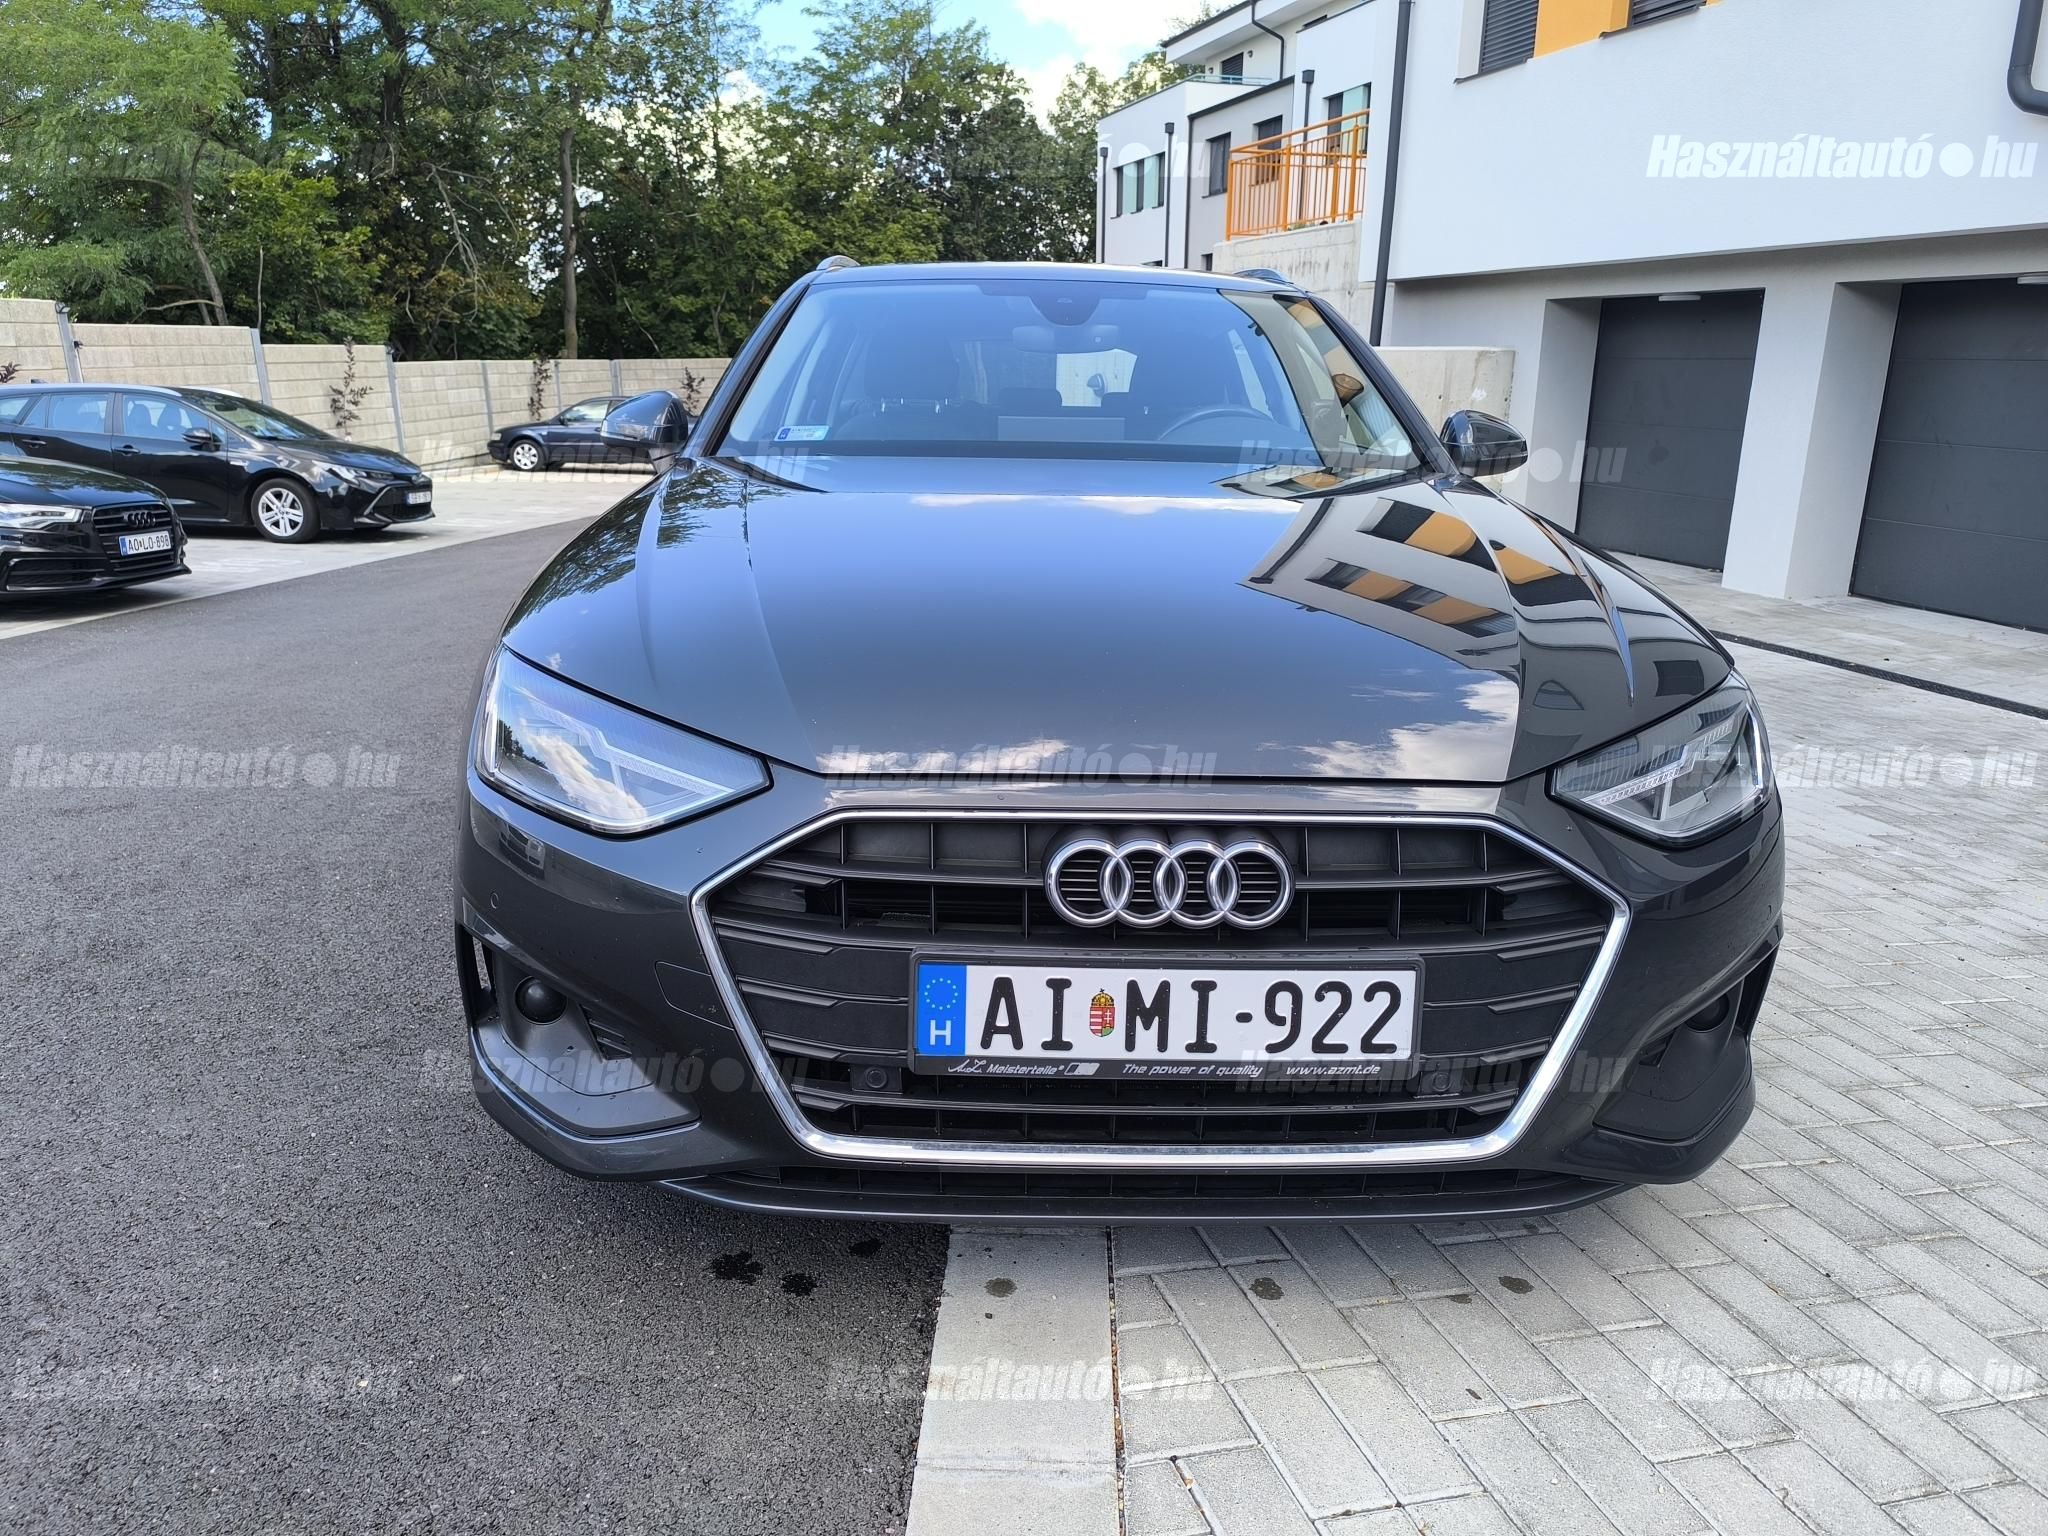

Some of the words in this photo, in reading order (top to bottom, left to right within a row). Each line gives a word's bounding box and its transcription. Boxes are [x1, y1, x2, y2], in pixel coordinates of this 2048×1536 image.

[980, 976, 1073, 1052] AI
[1124, 979, 1401, 1054] MI-922
[929, 1019, 952, 1046] H
[1121, 1063, 1147, 1074] The
[1148, 1065, 1196, 1076] power
[1197, 1064, 1215, 1075] of
[1215, 1064, 1264, 1078] quality
[1285, 1064, 1382, 1075] www.azmt.de
